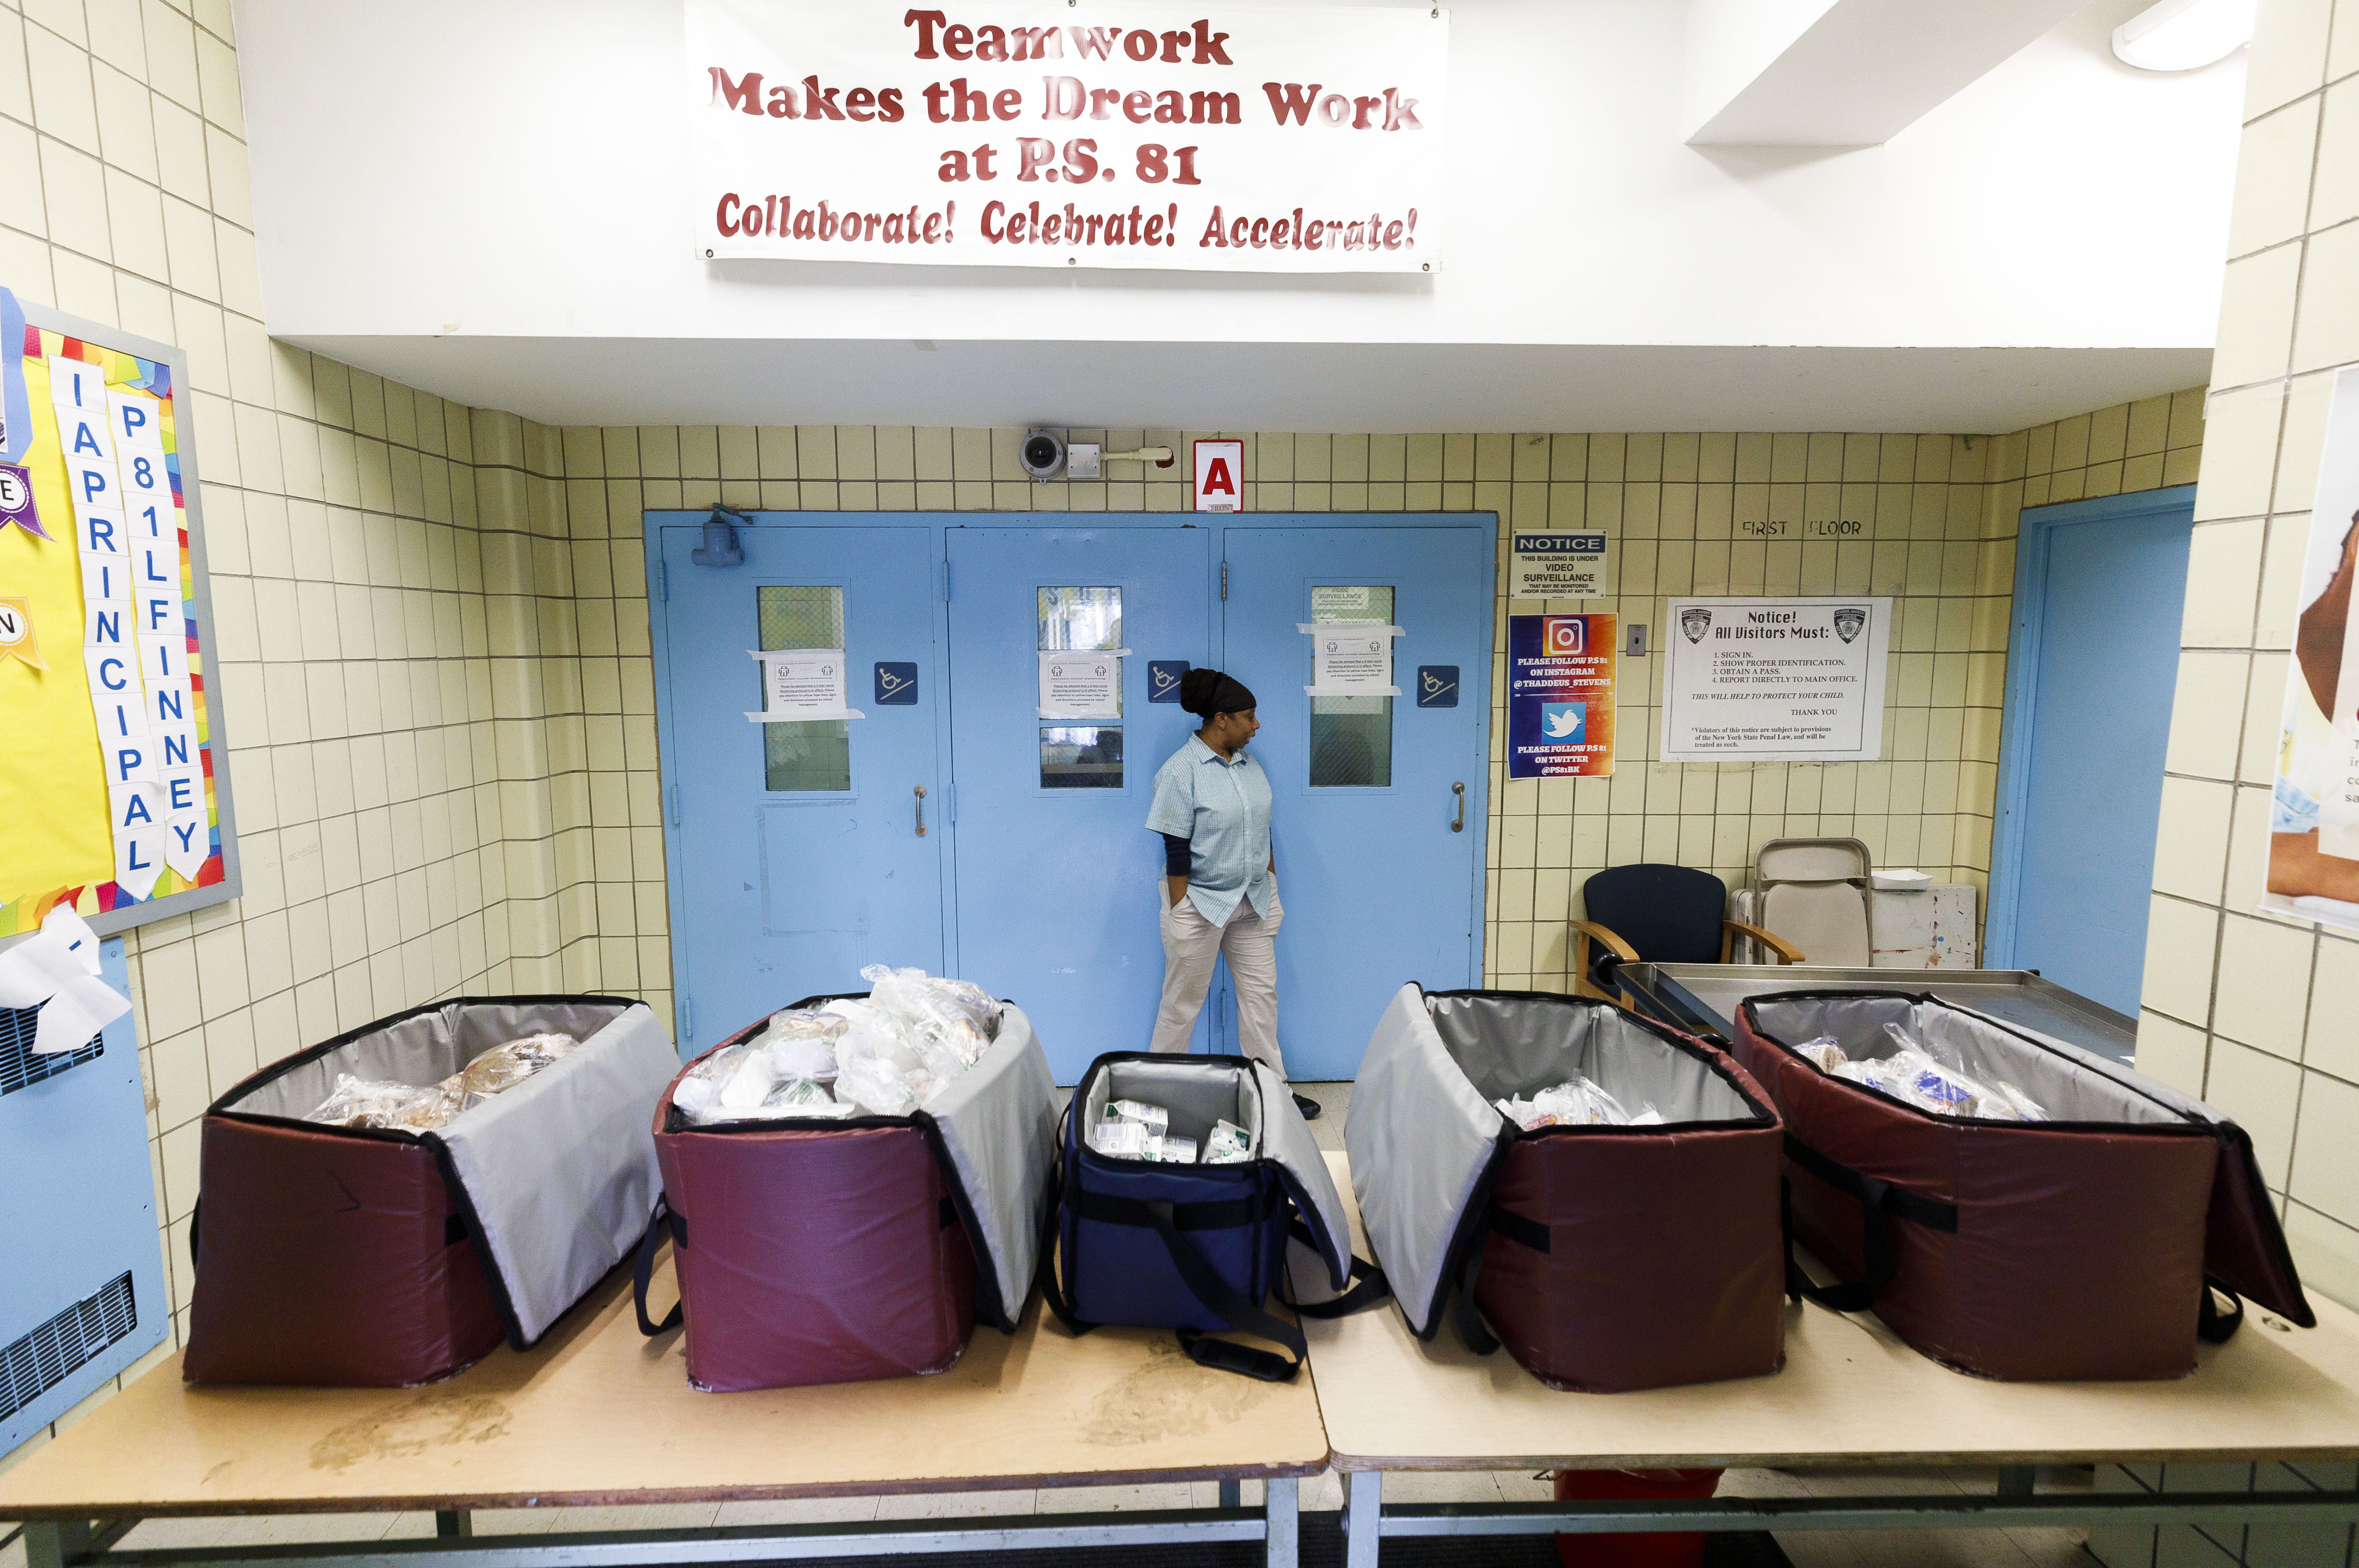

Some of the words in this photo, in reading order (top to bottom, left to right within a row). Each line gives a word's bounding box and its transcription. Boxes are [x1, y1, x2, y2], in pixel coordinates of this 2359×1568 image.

[904, 9, 1234, 66] Teamwork
[707, 67, 905, 123] Makes
[922, 78, 1022, 123] the
[1042, 75, 1241, 125] Dream
[1262, 82, 1424, 131] Work
[938, 141, 998, 184] at
[1015, 137, 1115, 184] P.S.
[1135, 143, 1202, 185] 81
[717, 193, 957, 245] Collaborate!
[980, 200, 1176, 247] Celebrate!
[1200, 205, 1418, 251] Accelerate!
[1202, 458, 1235, 494] A
[1743, 521, 1787, 535] FIRST
[1520, 539, 1600, 549] NOTICE
[1749, 611, 1796, 623] Notice!
[1716, 627, 1731, 639] All
[1736, 627, 1785, 639] Visitors
[1791, 626, 1828, 639] Must:
[1542, 766, 1580, 775] @PS81BK
